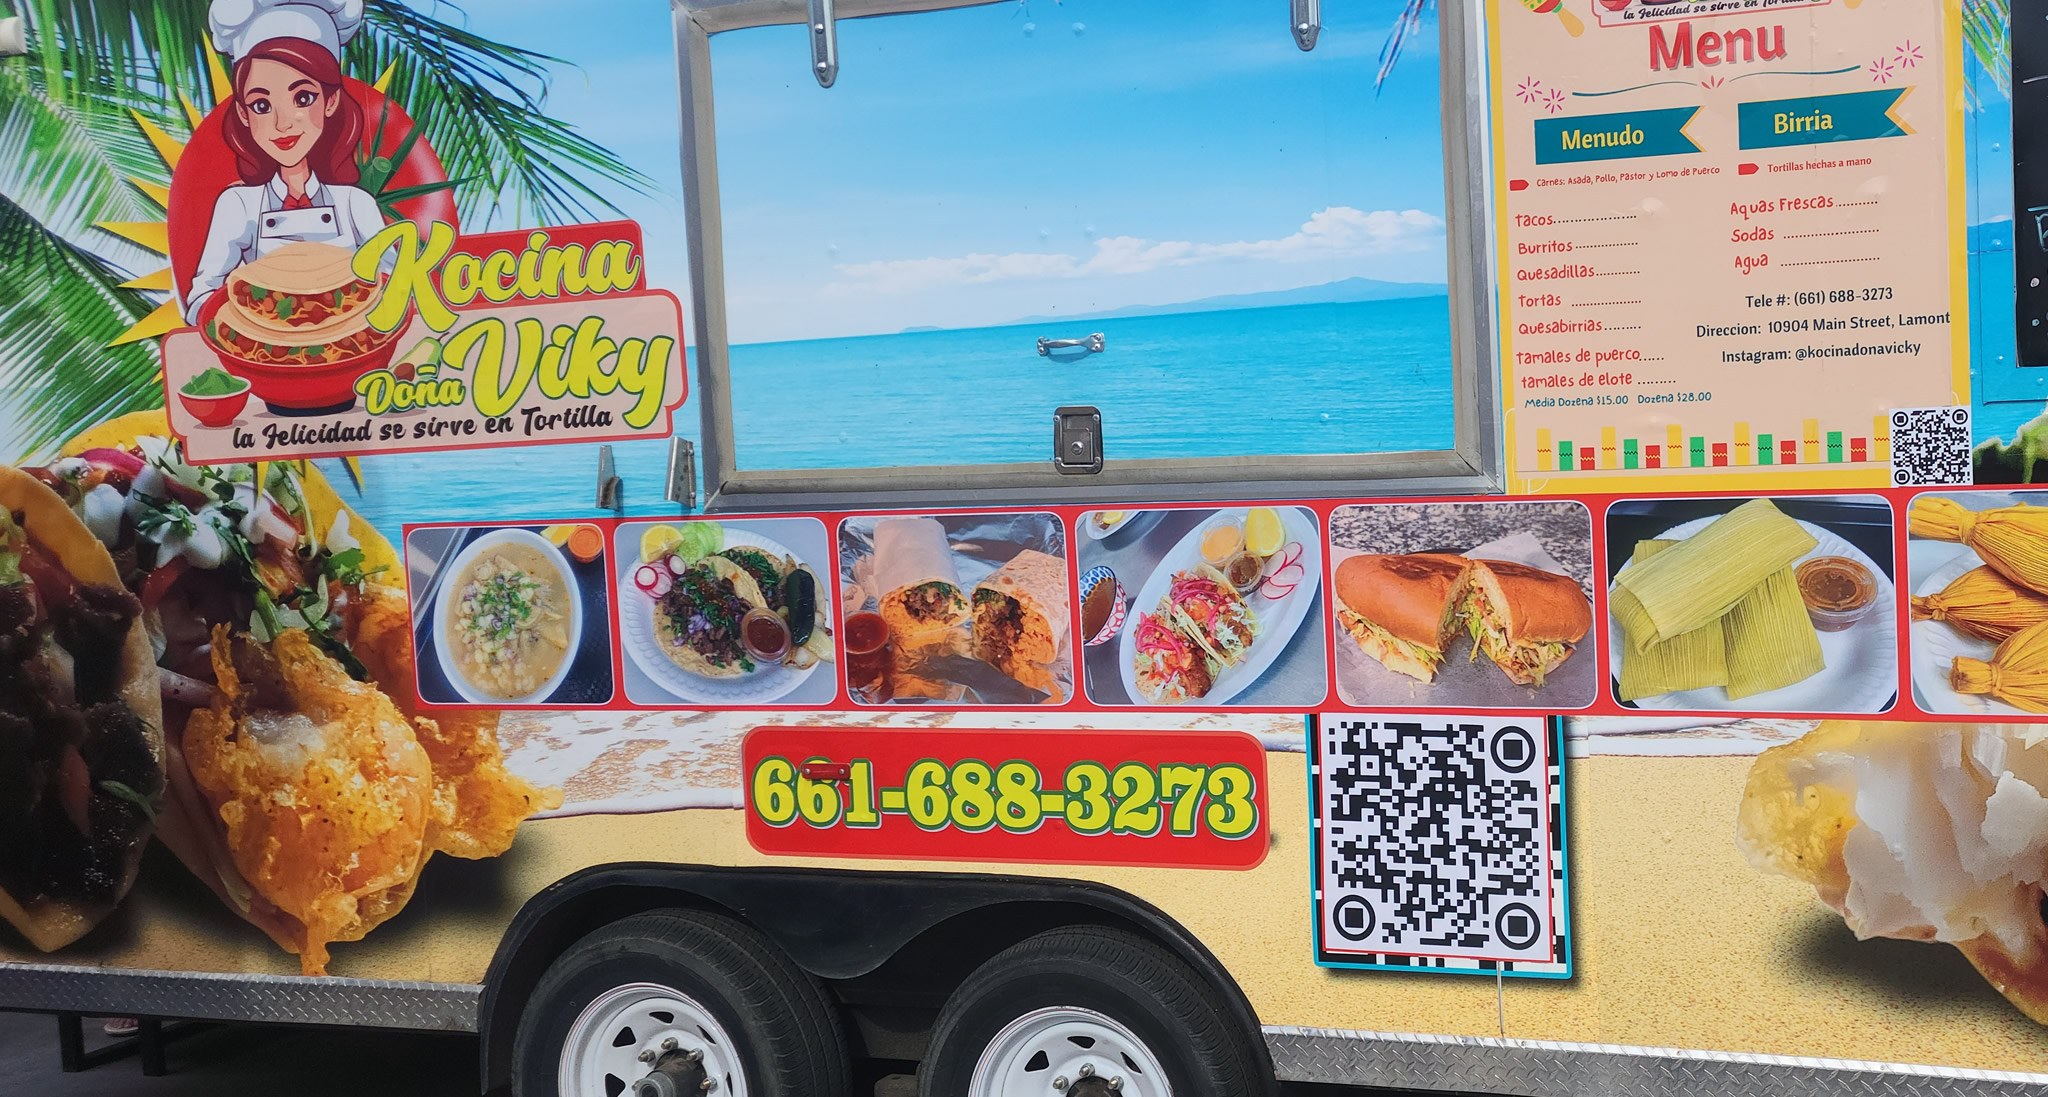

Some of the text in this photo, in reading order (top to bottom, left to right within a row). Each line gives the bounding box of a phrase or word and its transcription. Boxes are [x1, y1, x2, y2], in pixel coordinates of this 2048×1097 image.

[1623, 10, 1635, 20] la
[1638, 5, 1690, 20] Felicidad
[1694, 4, 1707, 13] se
[1710, 0, 1740, 12] sirve
[1648, 21, 1787, 72] Menu
[1773, 110, 1834, 135] Birria
[1561, 126, 1645, 151] Menudo
[1767, 158, 1872, 173] Tortillas hechas a mano
[1536, 166, 1720, 188] Carnes: Asada, Pollo, Pastor y Lomo de Puerco
[1779, 195, 1834, 212] Frescas
[1730, 226, 1775, 243] Sodas
[1518, 240, 1573, 255] Burritos
[1517, 264, 1595, 281] Quesadillas
[1734, 253, 1769, 275] Agua
[351, 219, 642, 333] Kocina
[1745, 286, 1893, 309] Tele #: (661) 688-3273
[1517, 319, 1603, 336] Quesabirrias
[1696, 311, 1951, 338] Direccion: 10904 Main Street, Lamont
[1575, 347, 1591, 363] de
[1595, 348, 1640, 368] puerco
[1722, 340, 1921, 365] Instagram: @kocinadonavicky
[354, 315, 674, 430] Doña Viky
[1521, 371, 1633, 390] tamales de elote
[1524, 391, 1712, 409] Media Dozena $15.00 Dozena $28.00
[232, 404, 613, 450] la Felicidad se sirve en Tortilla
[752, 755, 1260, 840] 661-688-3273
